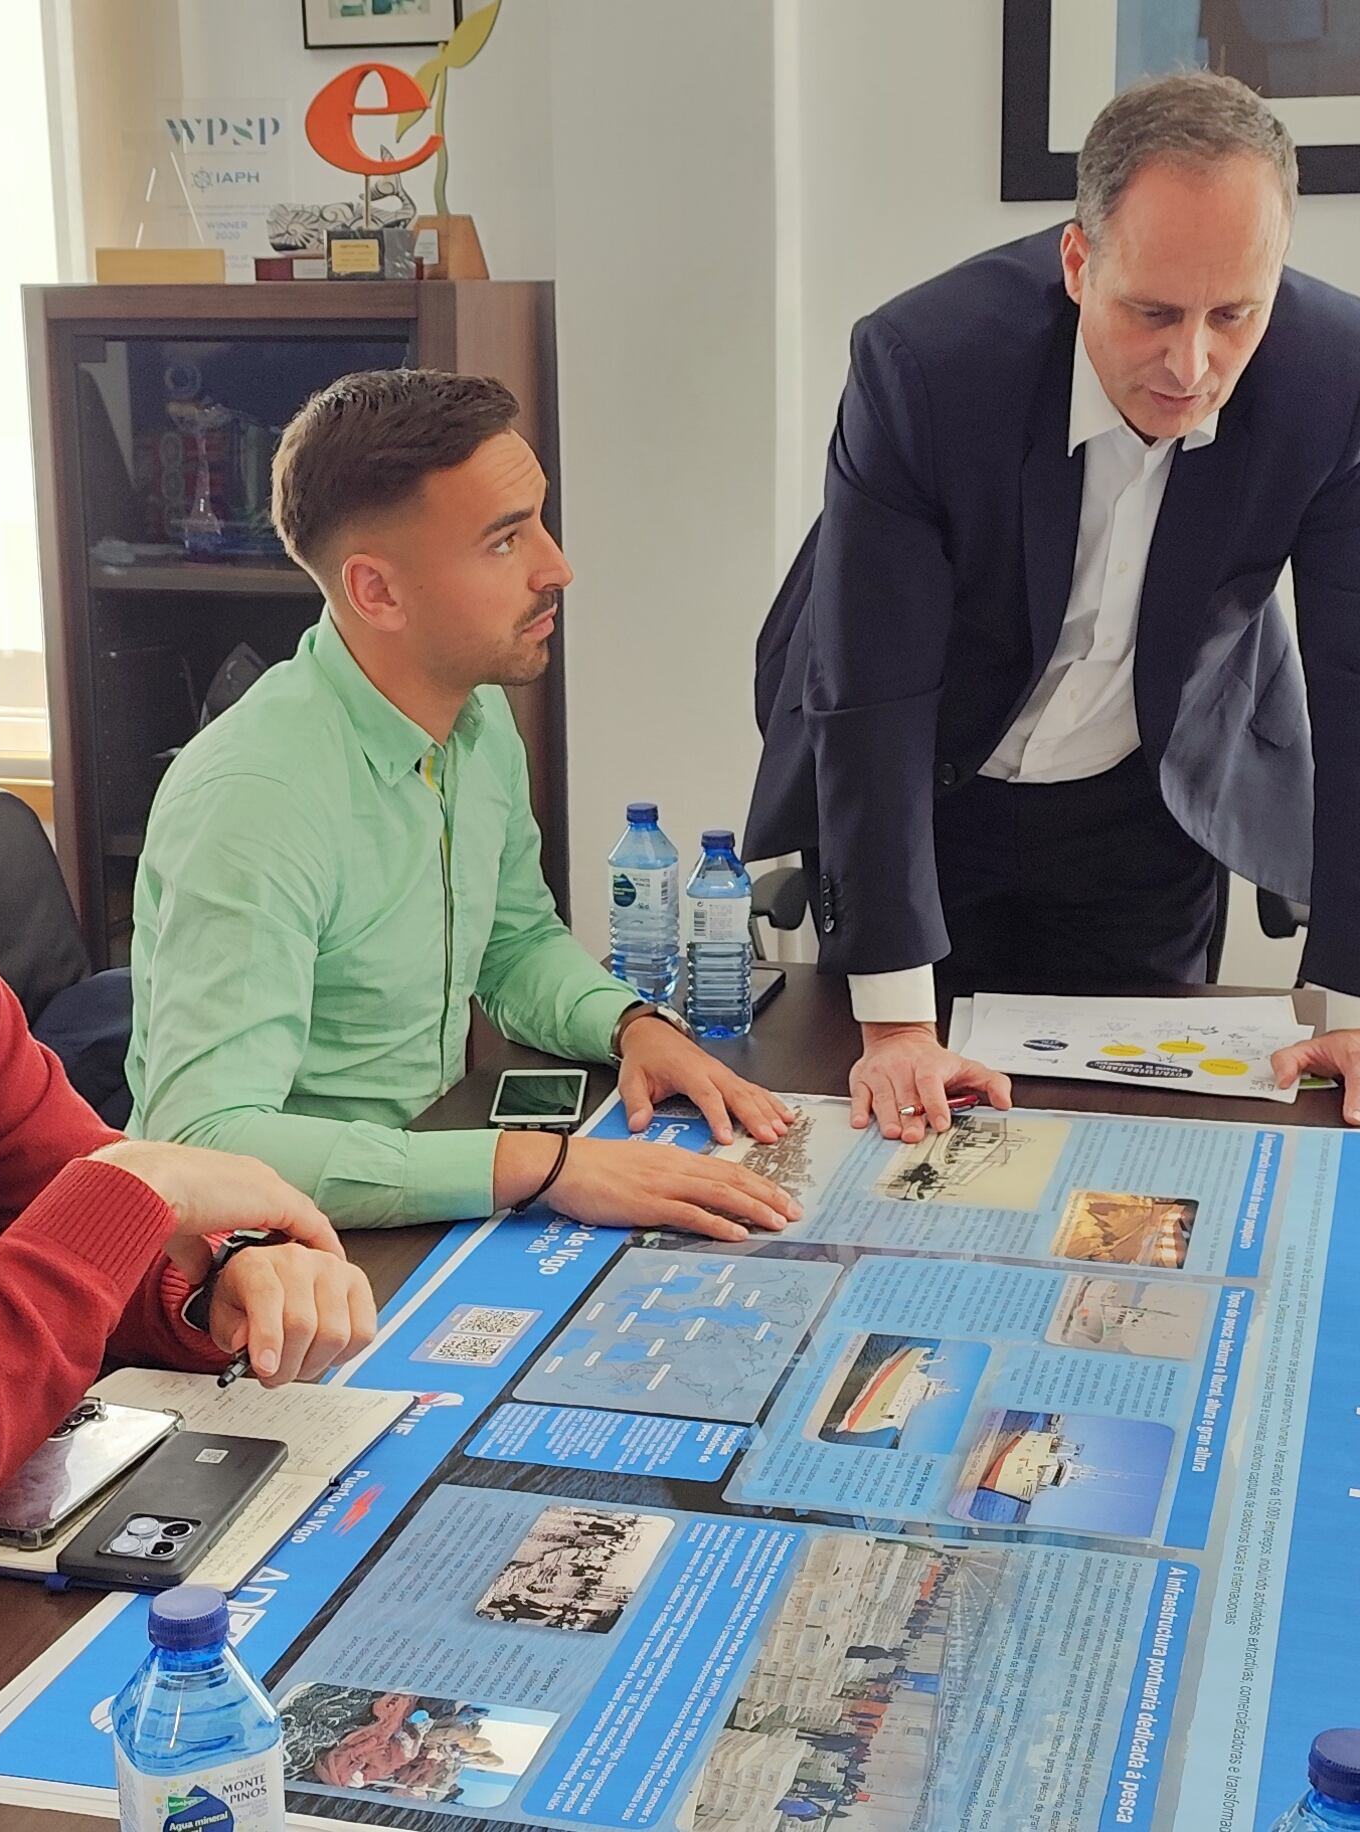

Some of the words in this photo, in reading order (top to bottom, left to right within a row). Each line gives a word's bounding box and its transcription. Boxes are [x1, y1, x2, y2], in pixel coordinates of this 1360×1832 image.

[166, 118, 280, 145] WPSP
[216, 171, 260, 183] IAPH
[525, 1233, 559, 1254] Path
[564, 1231, 595, 1246] de
[1240, 1218, 1255, 1248] pesqueiro
[539, 1245, 584, 1275] Vigo
[1227, 1291, 1244, 1308] Tipos
[1226, 1309, 1240, 1317] de
[1216, 1340, 1234, 1366] baixura
[1204, 1398, 1221, 1419] altura
[1197, 1426, 1212, 1445] gran
[1193, 1447, 1211, 1472] altura
[328, 1470, 370, 1510] Puerto
[314, 1504, 337, 1518] de
[290, 1516, 328, 1544] Vigo
[1169, 1567, 1186, 1575] A
[1225, 1574, 1243, 1624] internacionais
[1153, 1578, 1182, 1656] infraestructura
[716, 1664, 728, 1676] Vigo
[1142, 1658, 1164, 1710] portuaria
[1230, 1686, 1251, 1764] comercializadoras
[1129, 1713, 1155, 1768] dedicada
[590, 1758, 600, 1766] de
[221, 1774, 267, 1795] MONTE
[658, 1779, 669, 1787] de
[1126, 1771, 1145, 1779] á
[229, 1785, 268, 1804] PINOS
[563, 1783, 585, 1812] empresas
[642, 1788, 663, 1816] promover
[1117, 1782, 1138, 1823] pesca
[194, 1810, 229, 1827] mineral
